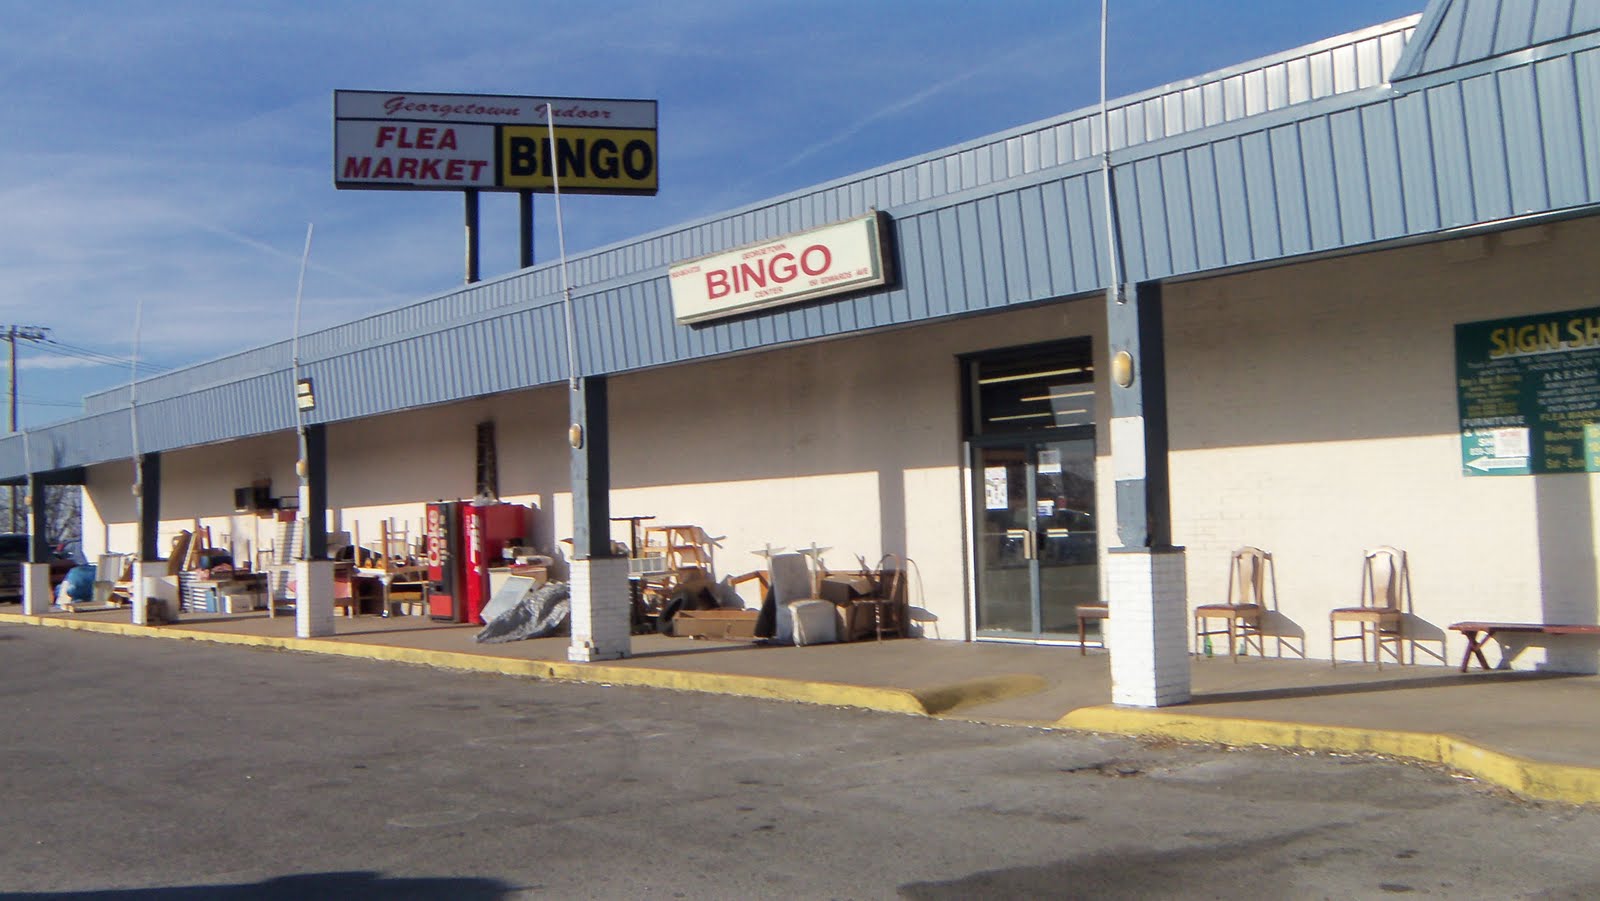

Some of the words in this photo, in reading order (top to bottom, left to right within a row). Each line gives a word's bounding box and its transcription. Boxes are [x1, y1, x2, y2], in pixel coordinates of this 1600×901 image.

[383, 95, 521, 118] Georgetown
[534, 102, 612, 119] Indoor
[375, 126, 457, 150] FLEA
[343, 156, 488, 181] MARKET
[508, 136, 653, 180] BINGO
[706, 245, 831, 299] BINGO
[754, 286, 784, 299] CENTER
[1490, 323, 1560, 356] SIGN
[1463, 415, 1526, 427] FURNITURE
